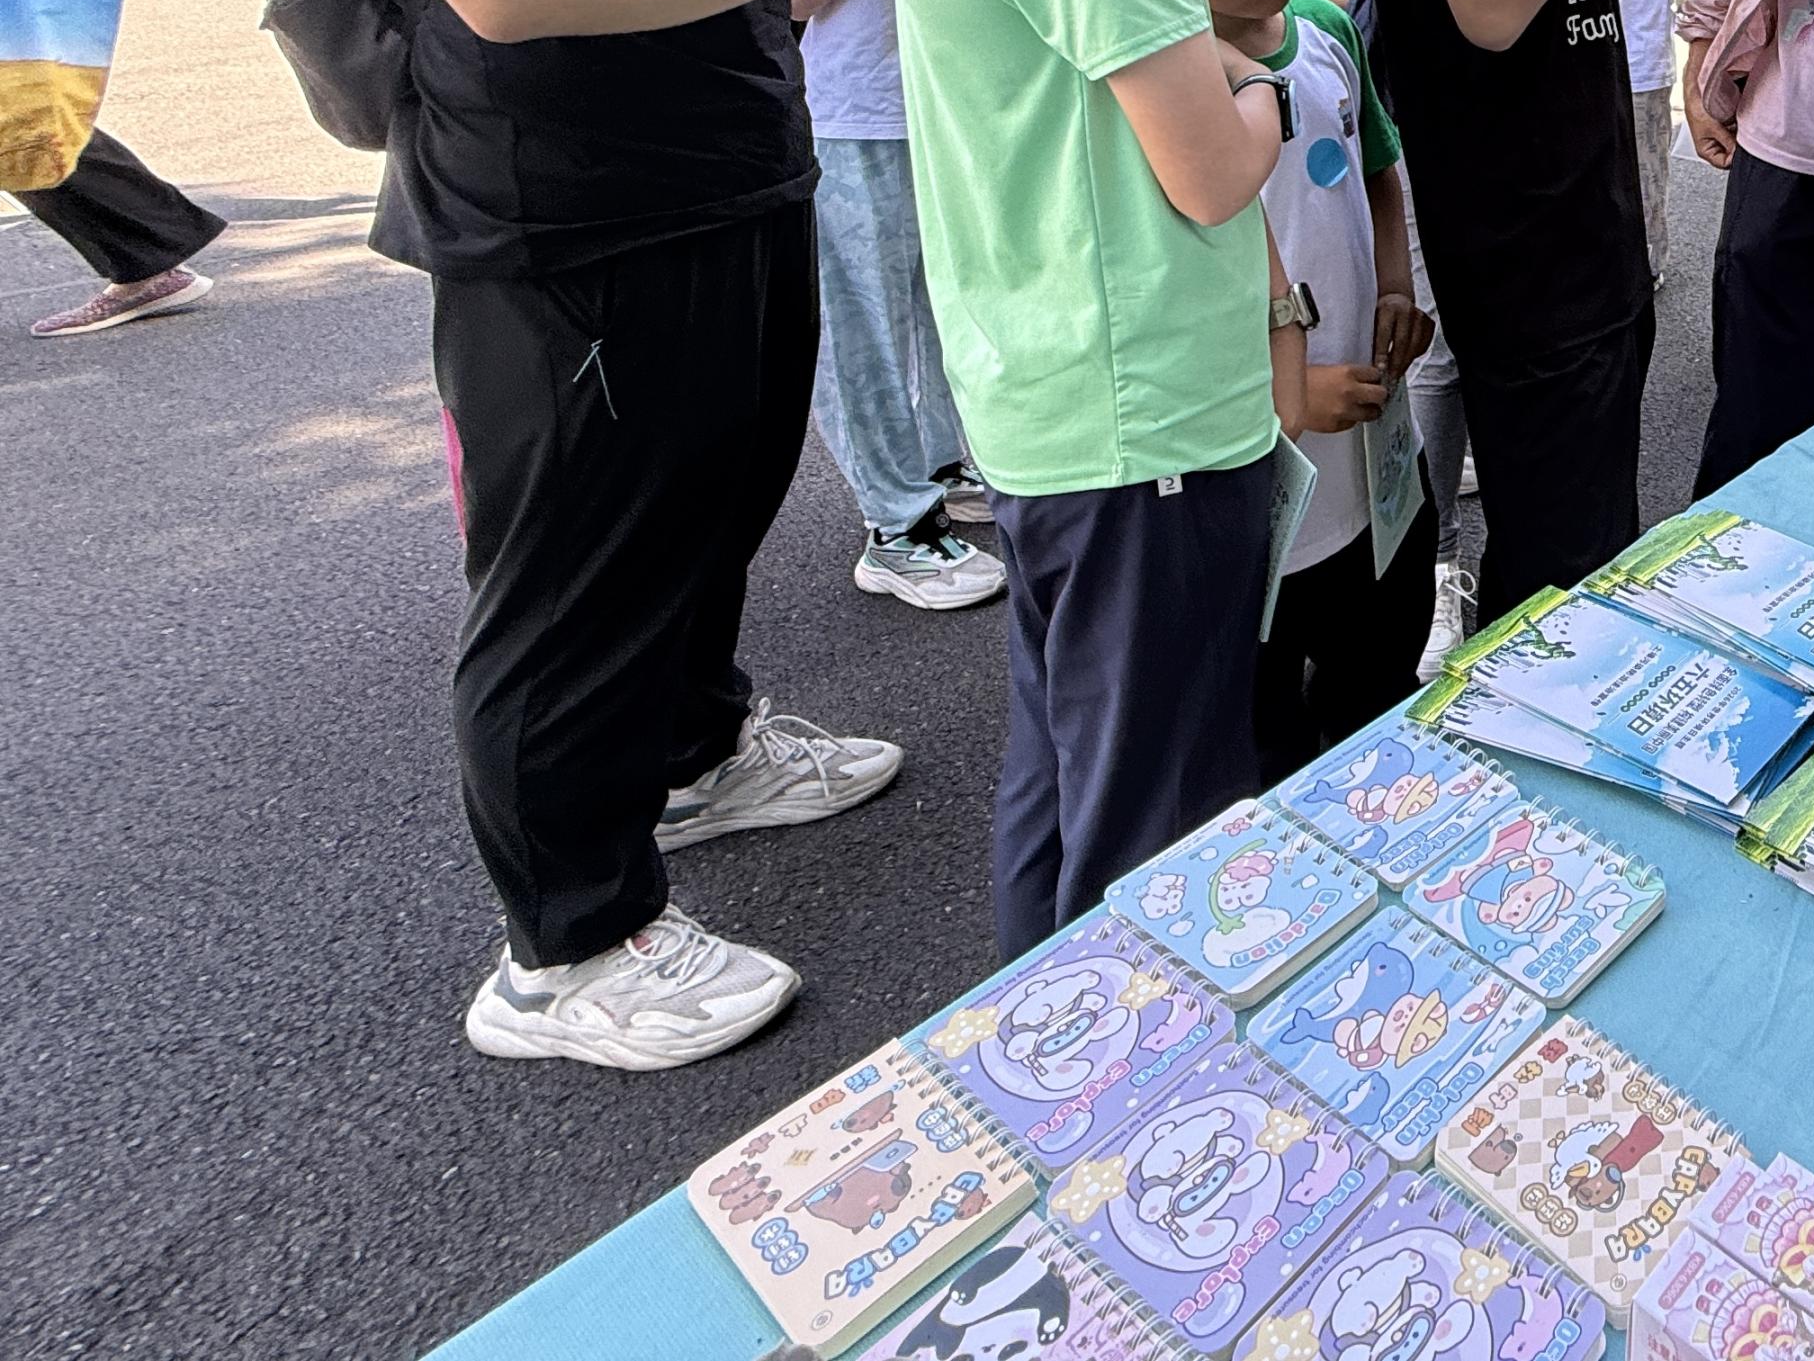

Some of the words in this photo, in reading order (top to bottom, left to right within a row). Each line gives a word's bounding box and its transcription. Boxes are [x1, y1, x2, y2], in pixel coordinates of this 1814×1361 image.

[1624, 661, 1714, 738] 六五环境日
[1685, 665, 1739, 712] 全面绿色转型
[1639, 707, 1695, 756] 构建美丽中国
[1388, 819, 1464, 878] Dolphin
[1539, 934, 1602, 994] Beach
[1128, 1021, 1212, 1090] Ocean
[1023, 1057, 1132, 1145] Explore
[1378, 1074, 1437, 1132] Bear
[1393, 1059, 1484, 1148] Dolphin
[826, 1175, 983, 1299] CAPYBARA
[1277, 1165, 1367, 1251] Ocean
[1603, 1146, 1708, 1261] CAPYBARA
[1168, 1212, 1282, 1325] Explore
